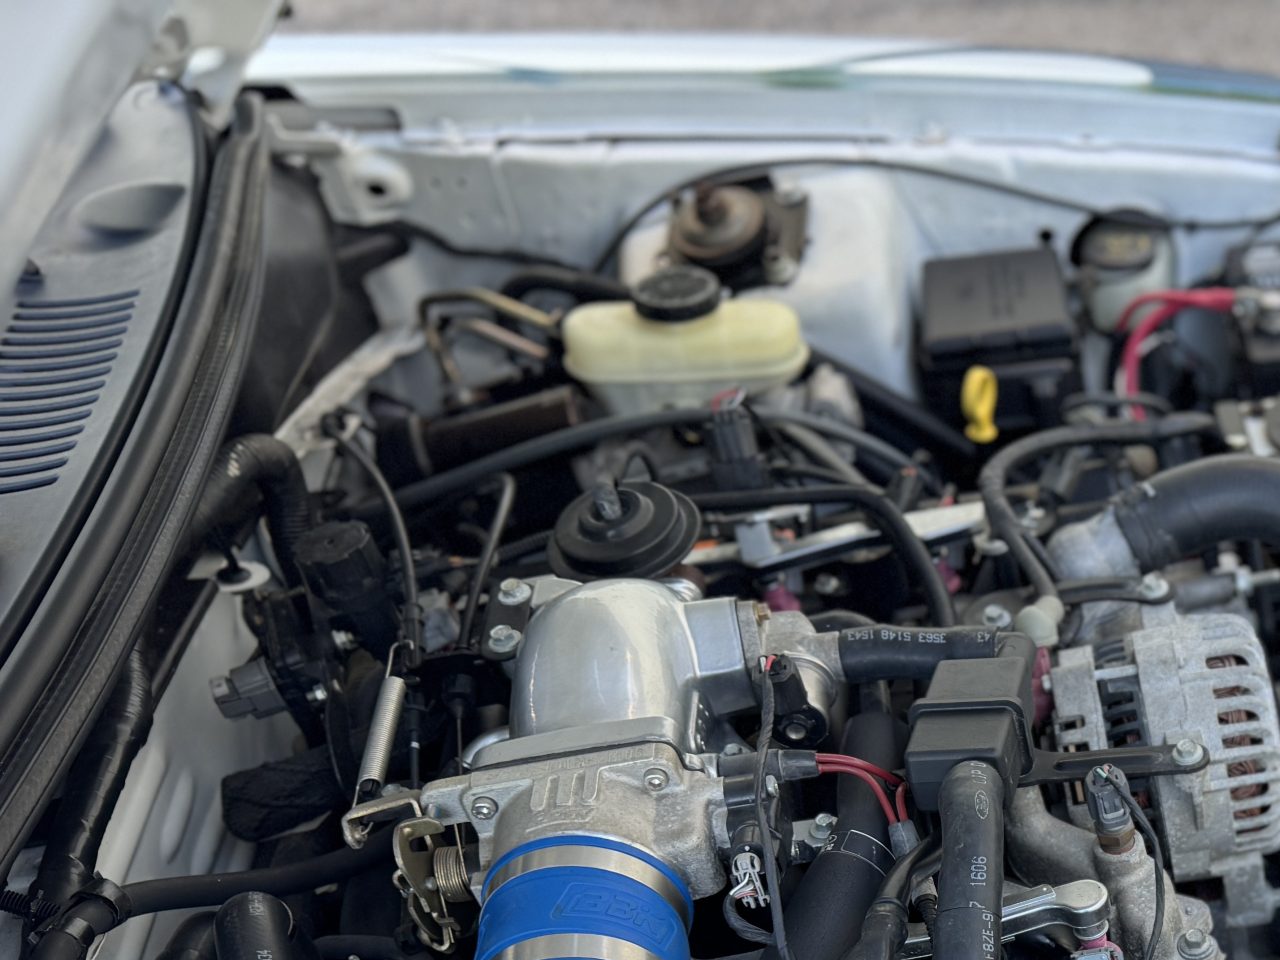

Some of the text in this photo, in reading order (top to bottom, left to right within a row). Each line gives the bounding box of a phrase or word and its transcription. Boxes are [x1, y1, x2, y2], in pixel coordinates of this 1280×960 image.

[847, 629, 874, 642] 1543
[880, 629, 912, 642] 5148
[918, 631, 947, 644] 3563
[969, 855, 988, 887] 1606
